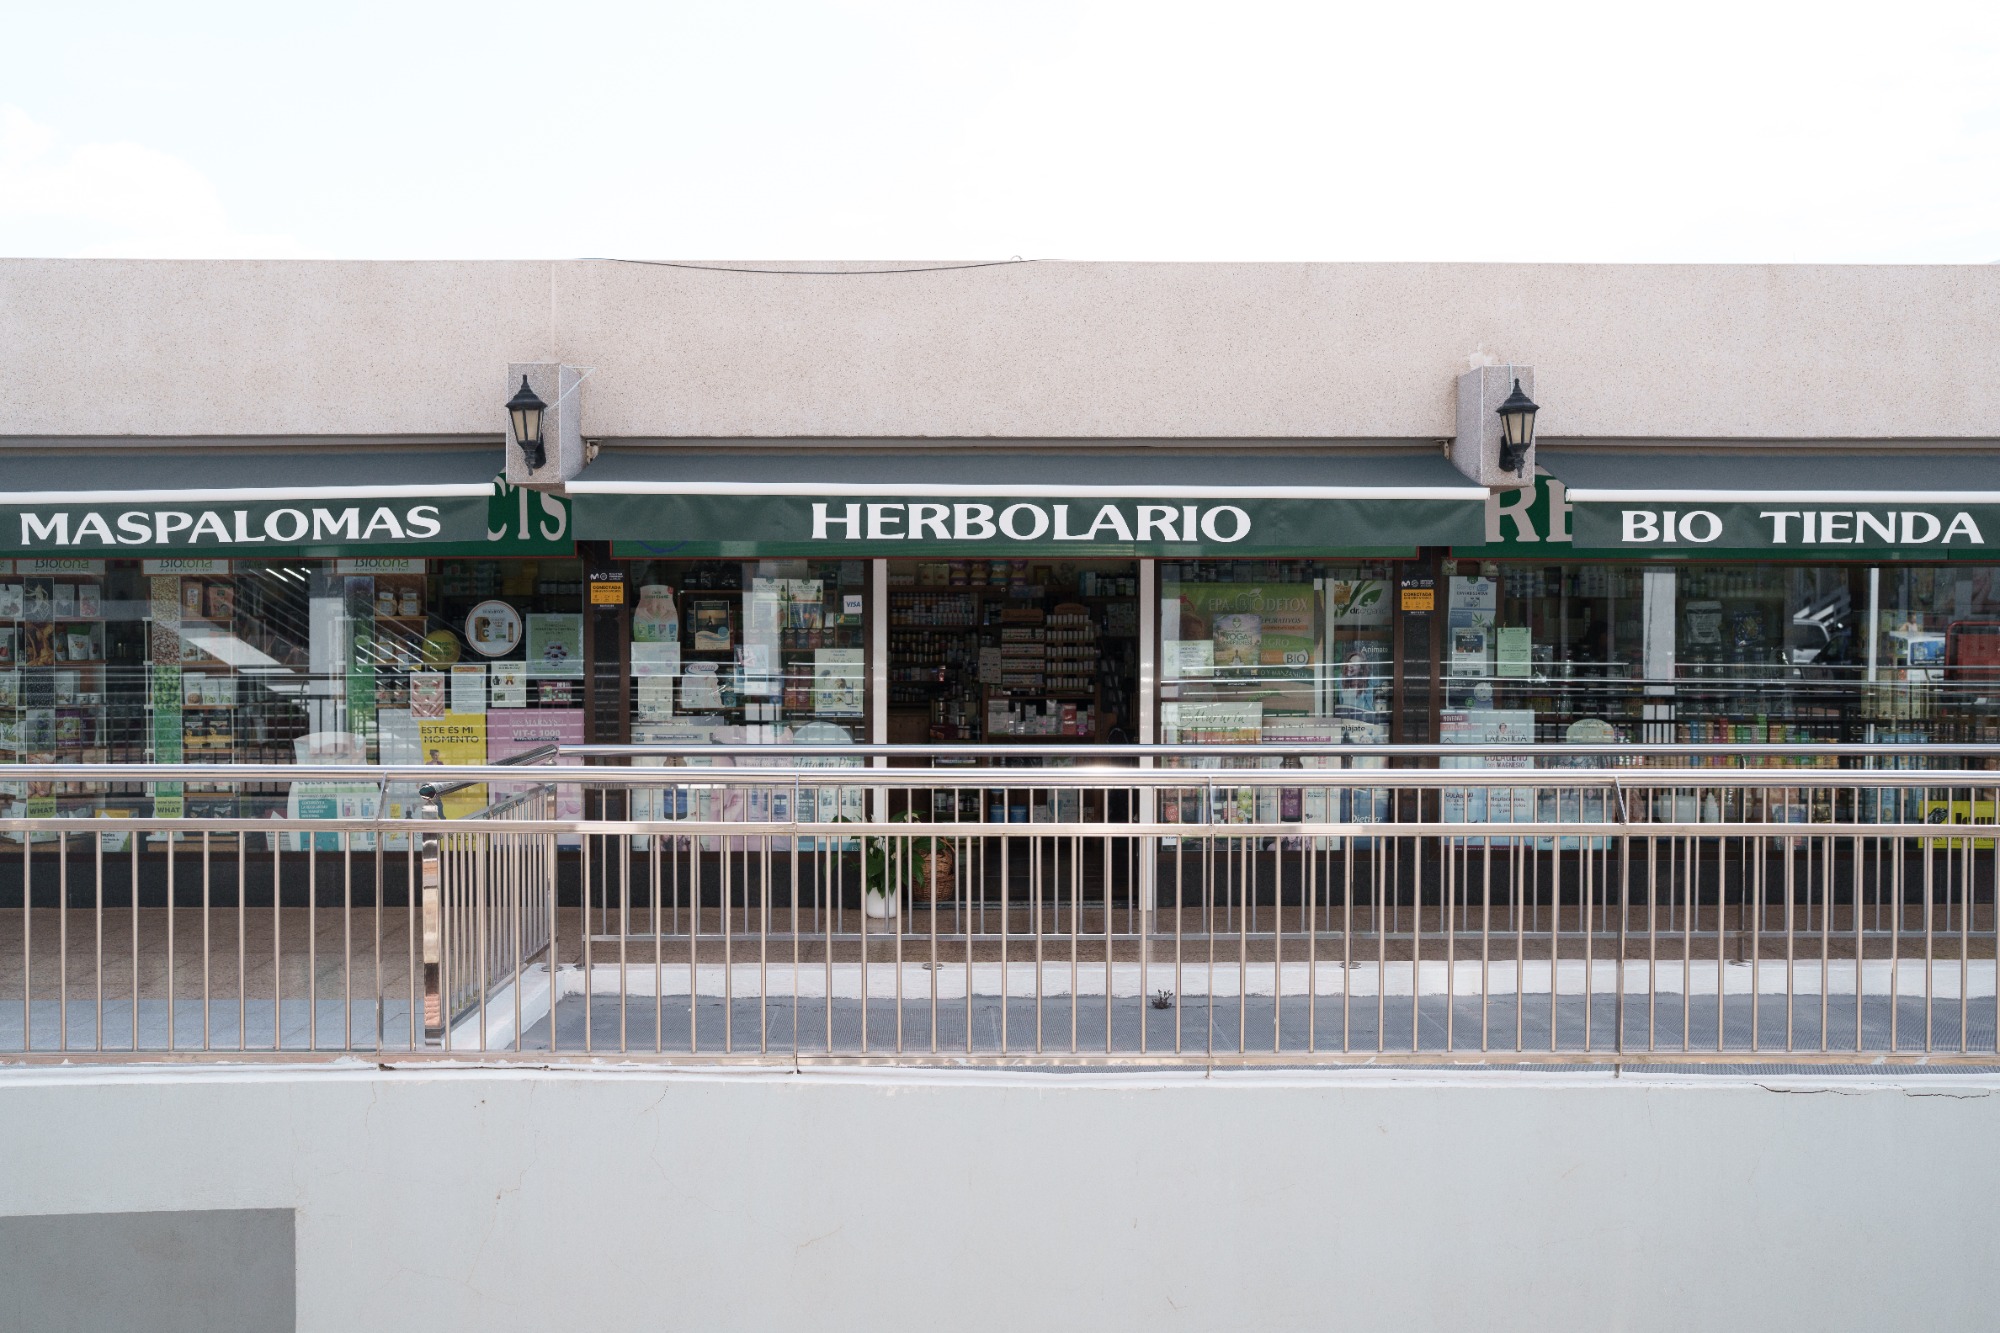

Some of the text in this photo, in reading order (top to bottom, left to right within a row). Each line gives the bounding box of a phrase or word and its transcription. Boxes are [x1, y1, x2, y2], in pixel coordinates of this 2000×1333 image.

[19, 505, 441, 545] MASPALOMAS
[811, 502, 1252, 543] HERBOLARIO
[1621, 510, 1985, 544] BIO TIENDA
[1286, 653, 1306, 664] BIO
[421, 726, 474, 734] ESTE ES MI
[512, 729, 561, 737] VIT-C 1000
[423, 735, 480, 743] MOMENTO
[29, 806, 54, 815] WHAT
[157, 806, 181, 814] WHAT
